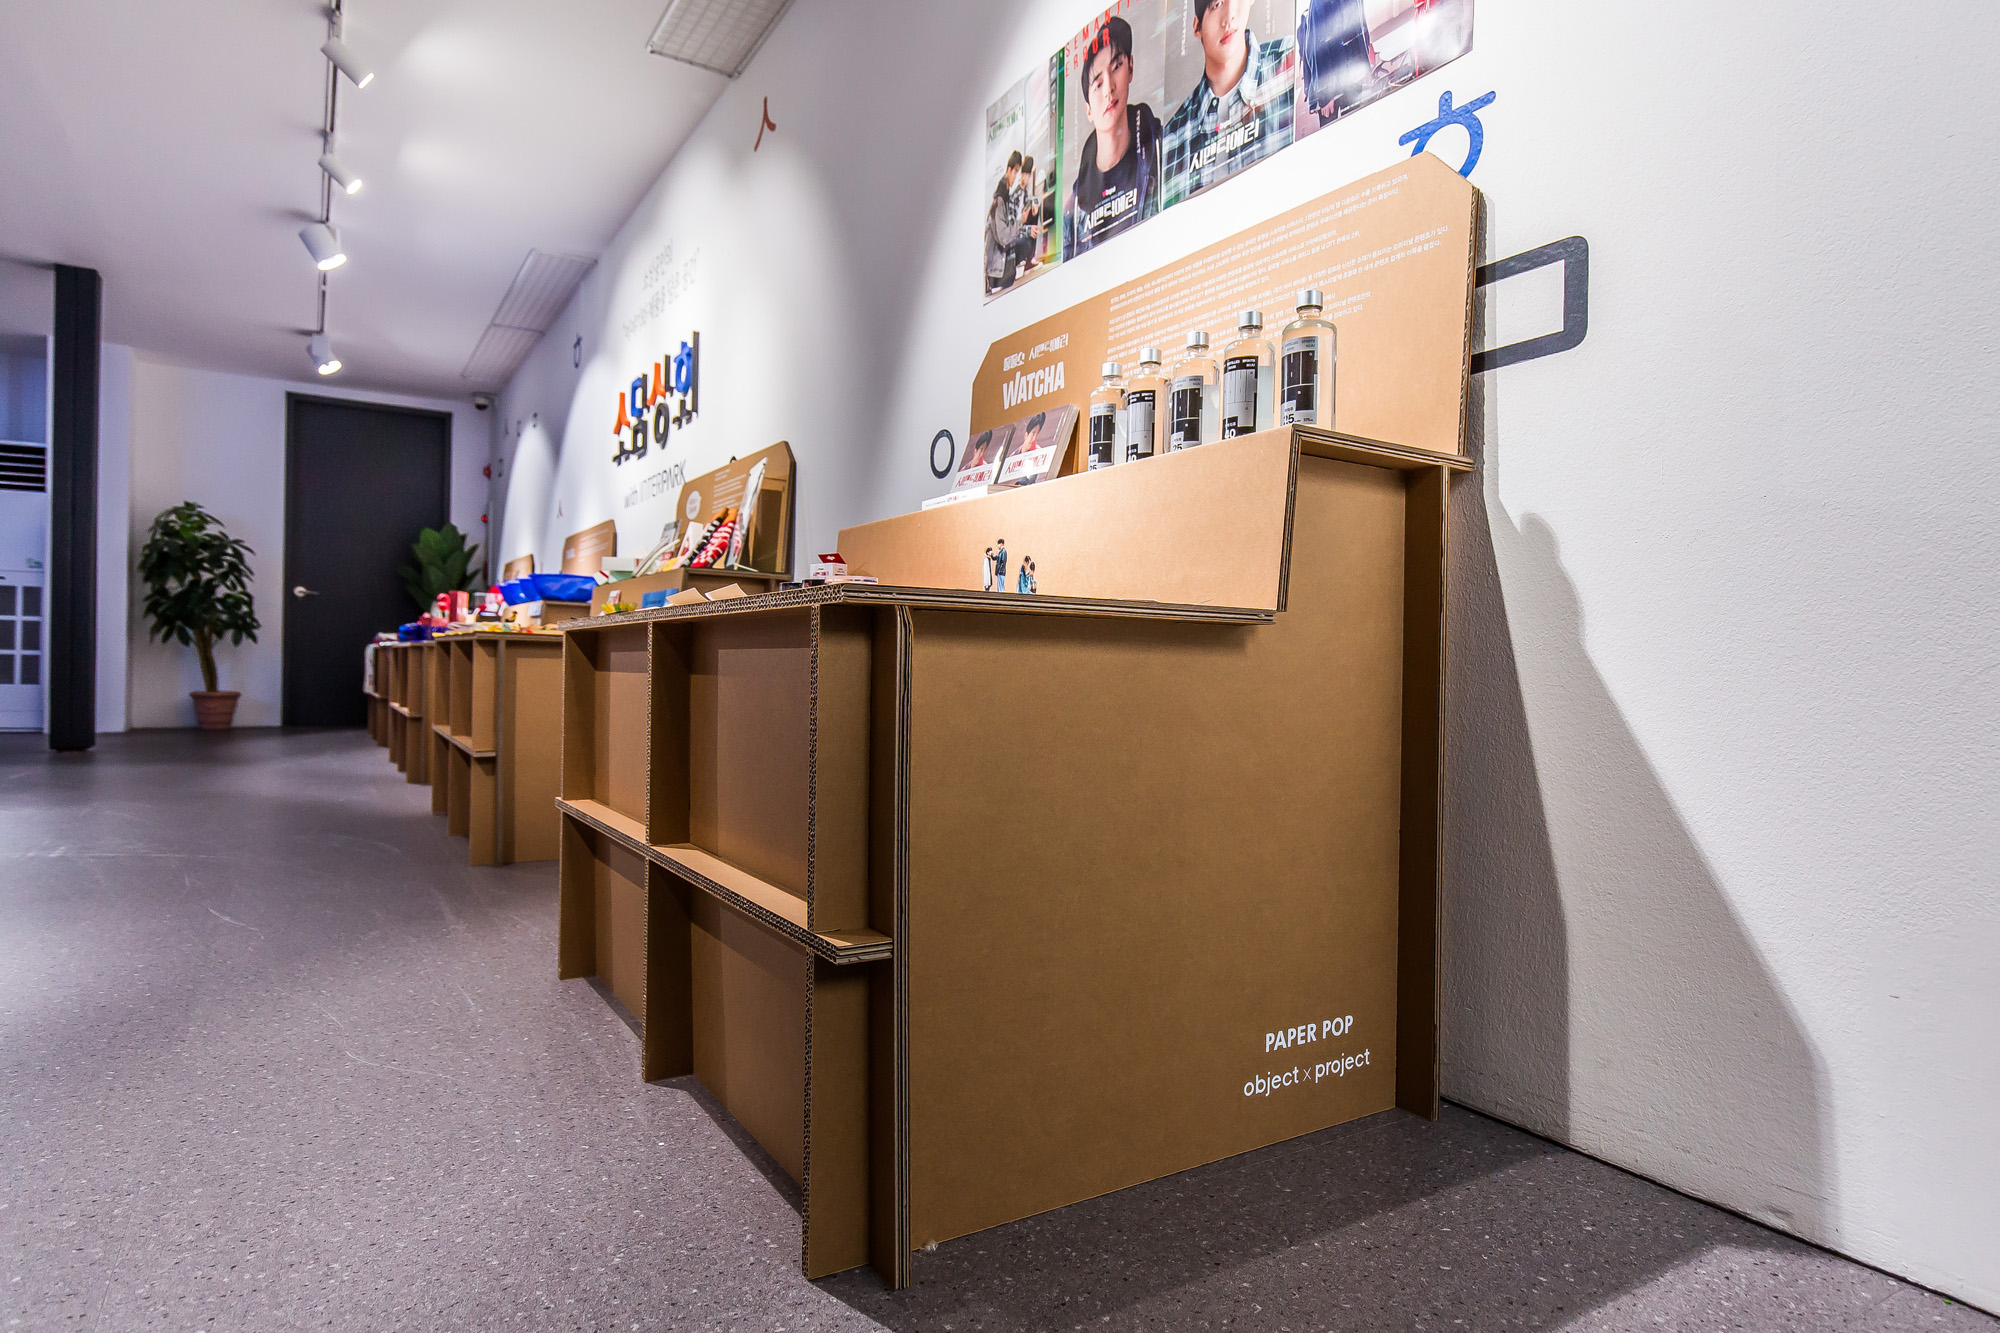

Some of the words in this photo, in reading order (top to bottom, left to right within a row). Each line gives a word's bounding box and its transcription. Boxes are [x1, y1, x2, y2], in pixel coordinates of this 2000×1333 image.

[1065, 28, 1110, 78] ERROR
[1003, 361, 1065, 410] WATCHA
[1265, 1023, 1317, 1053] PAPER
[1322, 1015, 1354, 1039] POP
[1243, 1066, 1299, 1097] object
[1314, 1048, 1371, 1084] project
